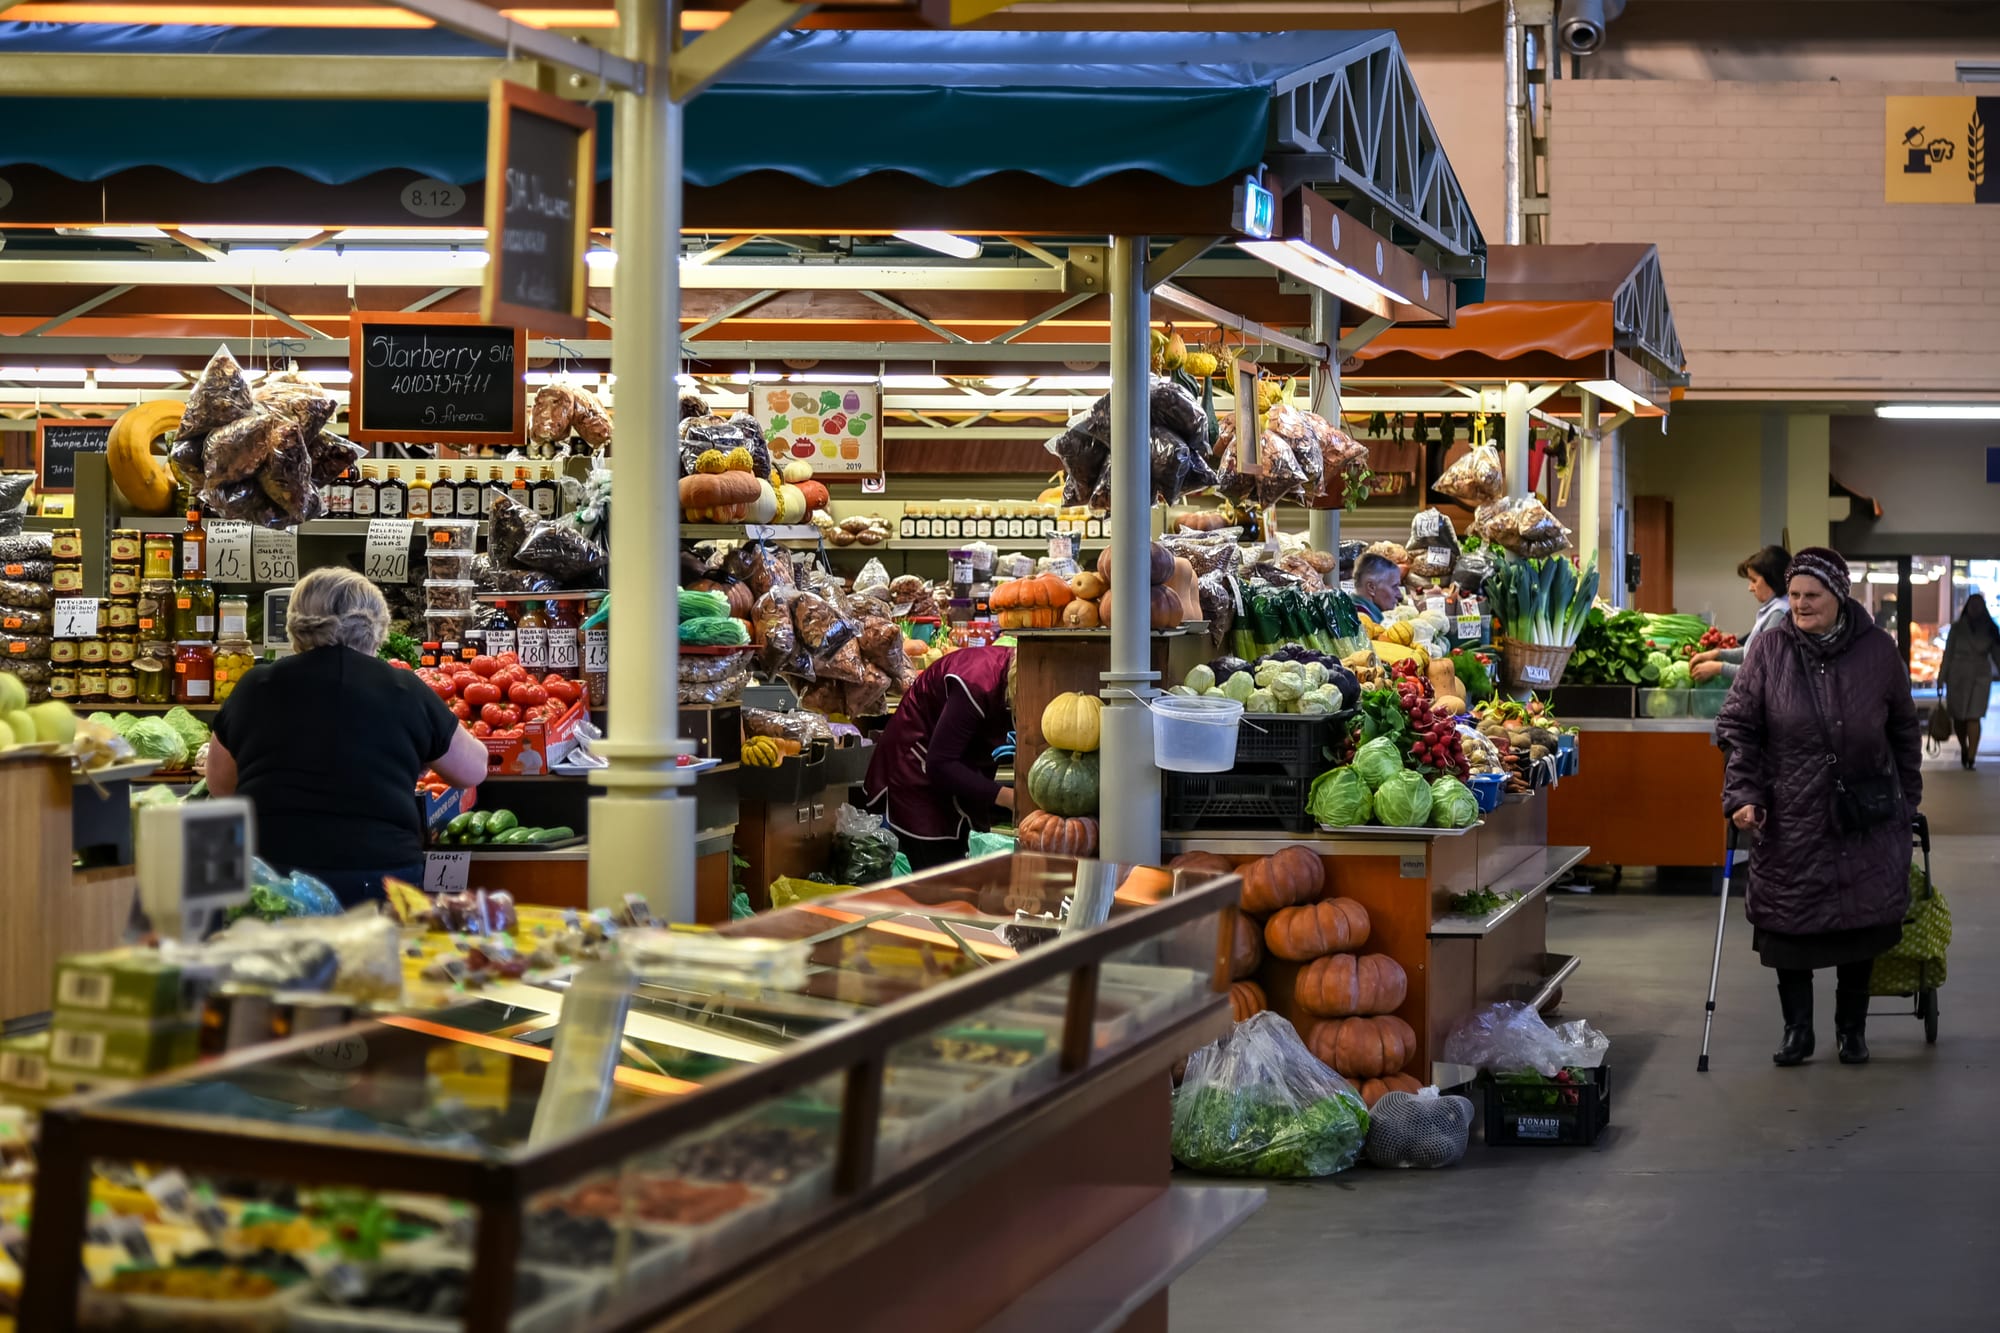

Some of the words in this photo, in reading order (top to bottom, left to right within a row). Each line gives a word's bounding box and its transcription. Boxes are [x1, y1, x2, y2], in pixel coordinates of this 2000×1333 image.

[411, 190, 456, 206] 8.12.
[367, 333, 482, 377] Starberry
[488, 344, 514, 363] SIA
[846, 462, 862, 471] 2019
[520, 645, 546, 664] 1,80
[1518, 1117, 1560, 1127] LEONARDI
